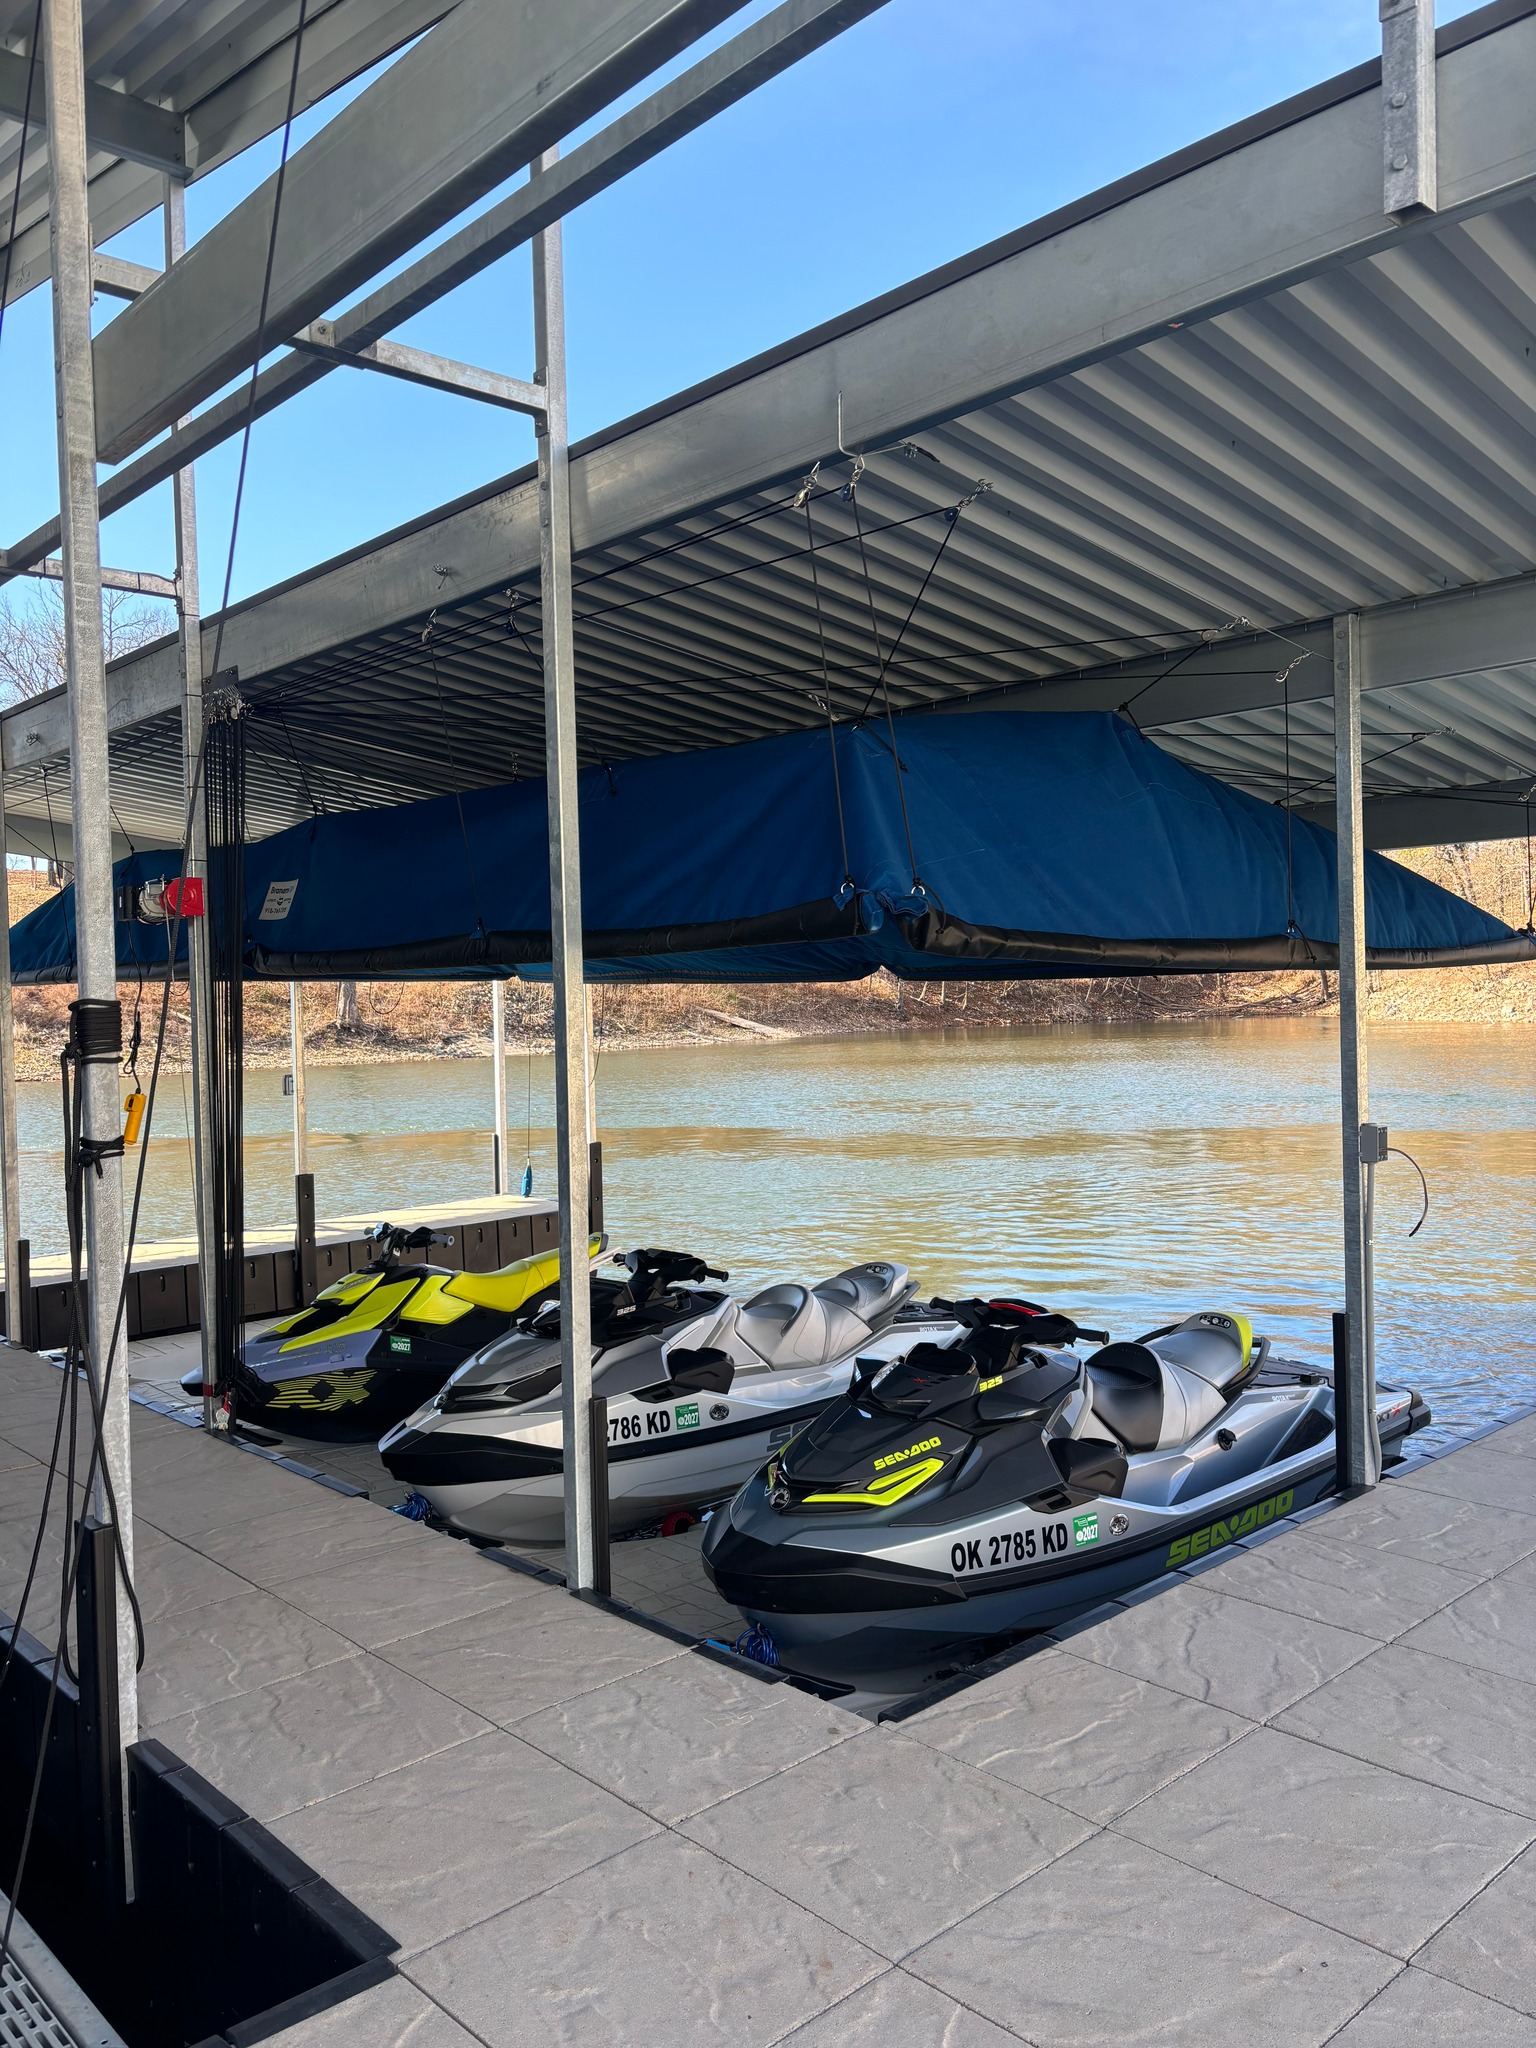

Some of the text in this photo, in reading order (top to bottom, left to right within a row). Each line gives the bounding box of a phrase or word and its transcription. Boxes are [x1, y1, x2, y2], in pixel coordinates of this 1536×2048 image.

[397, 1343, 410, 1351] 2027
[979, 1375, 1003, 1393] 325
[606, 1410, 671, 1442] 786 KD
[684, 1412, 699, 1425] 2027
[1082, 1523, 1099, 1541] 2027
[951, 1523, 1069, 1572] OK 2785 KD
